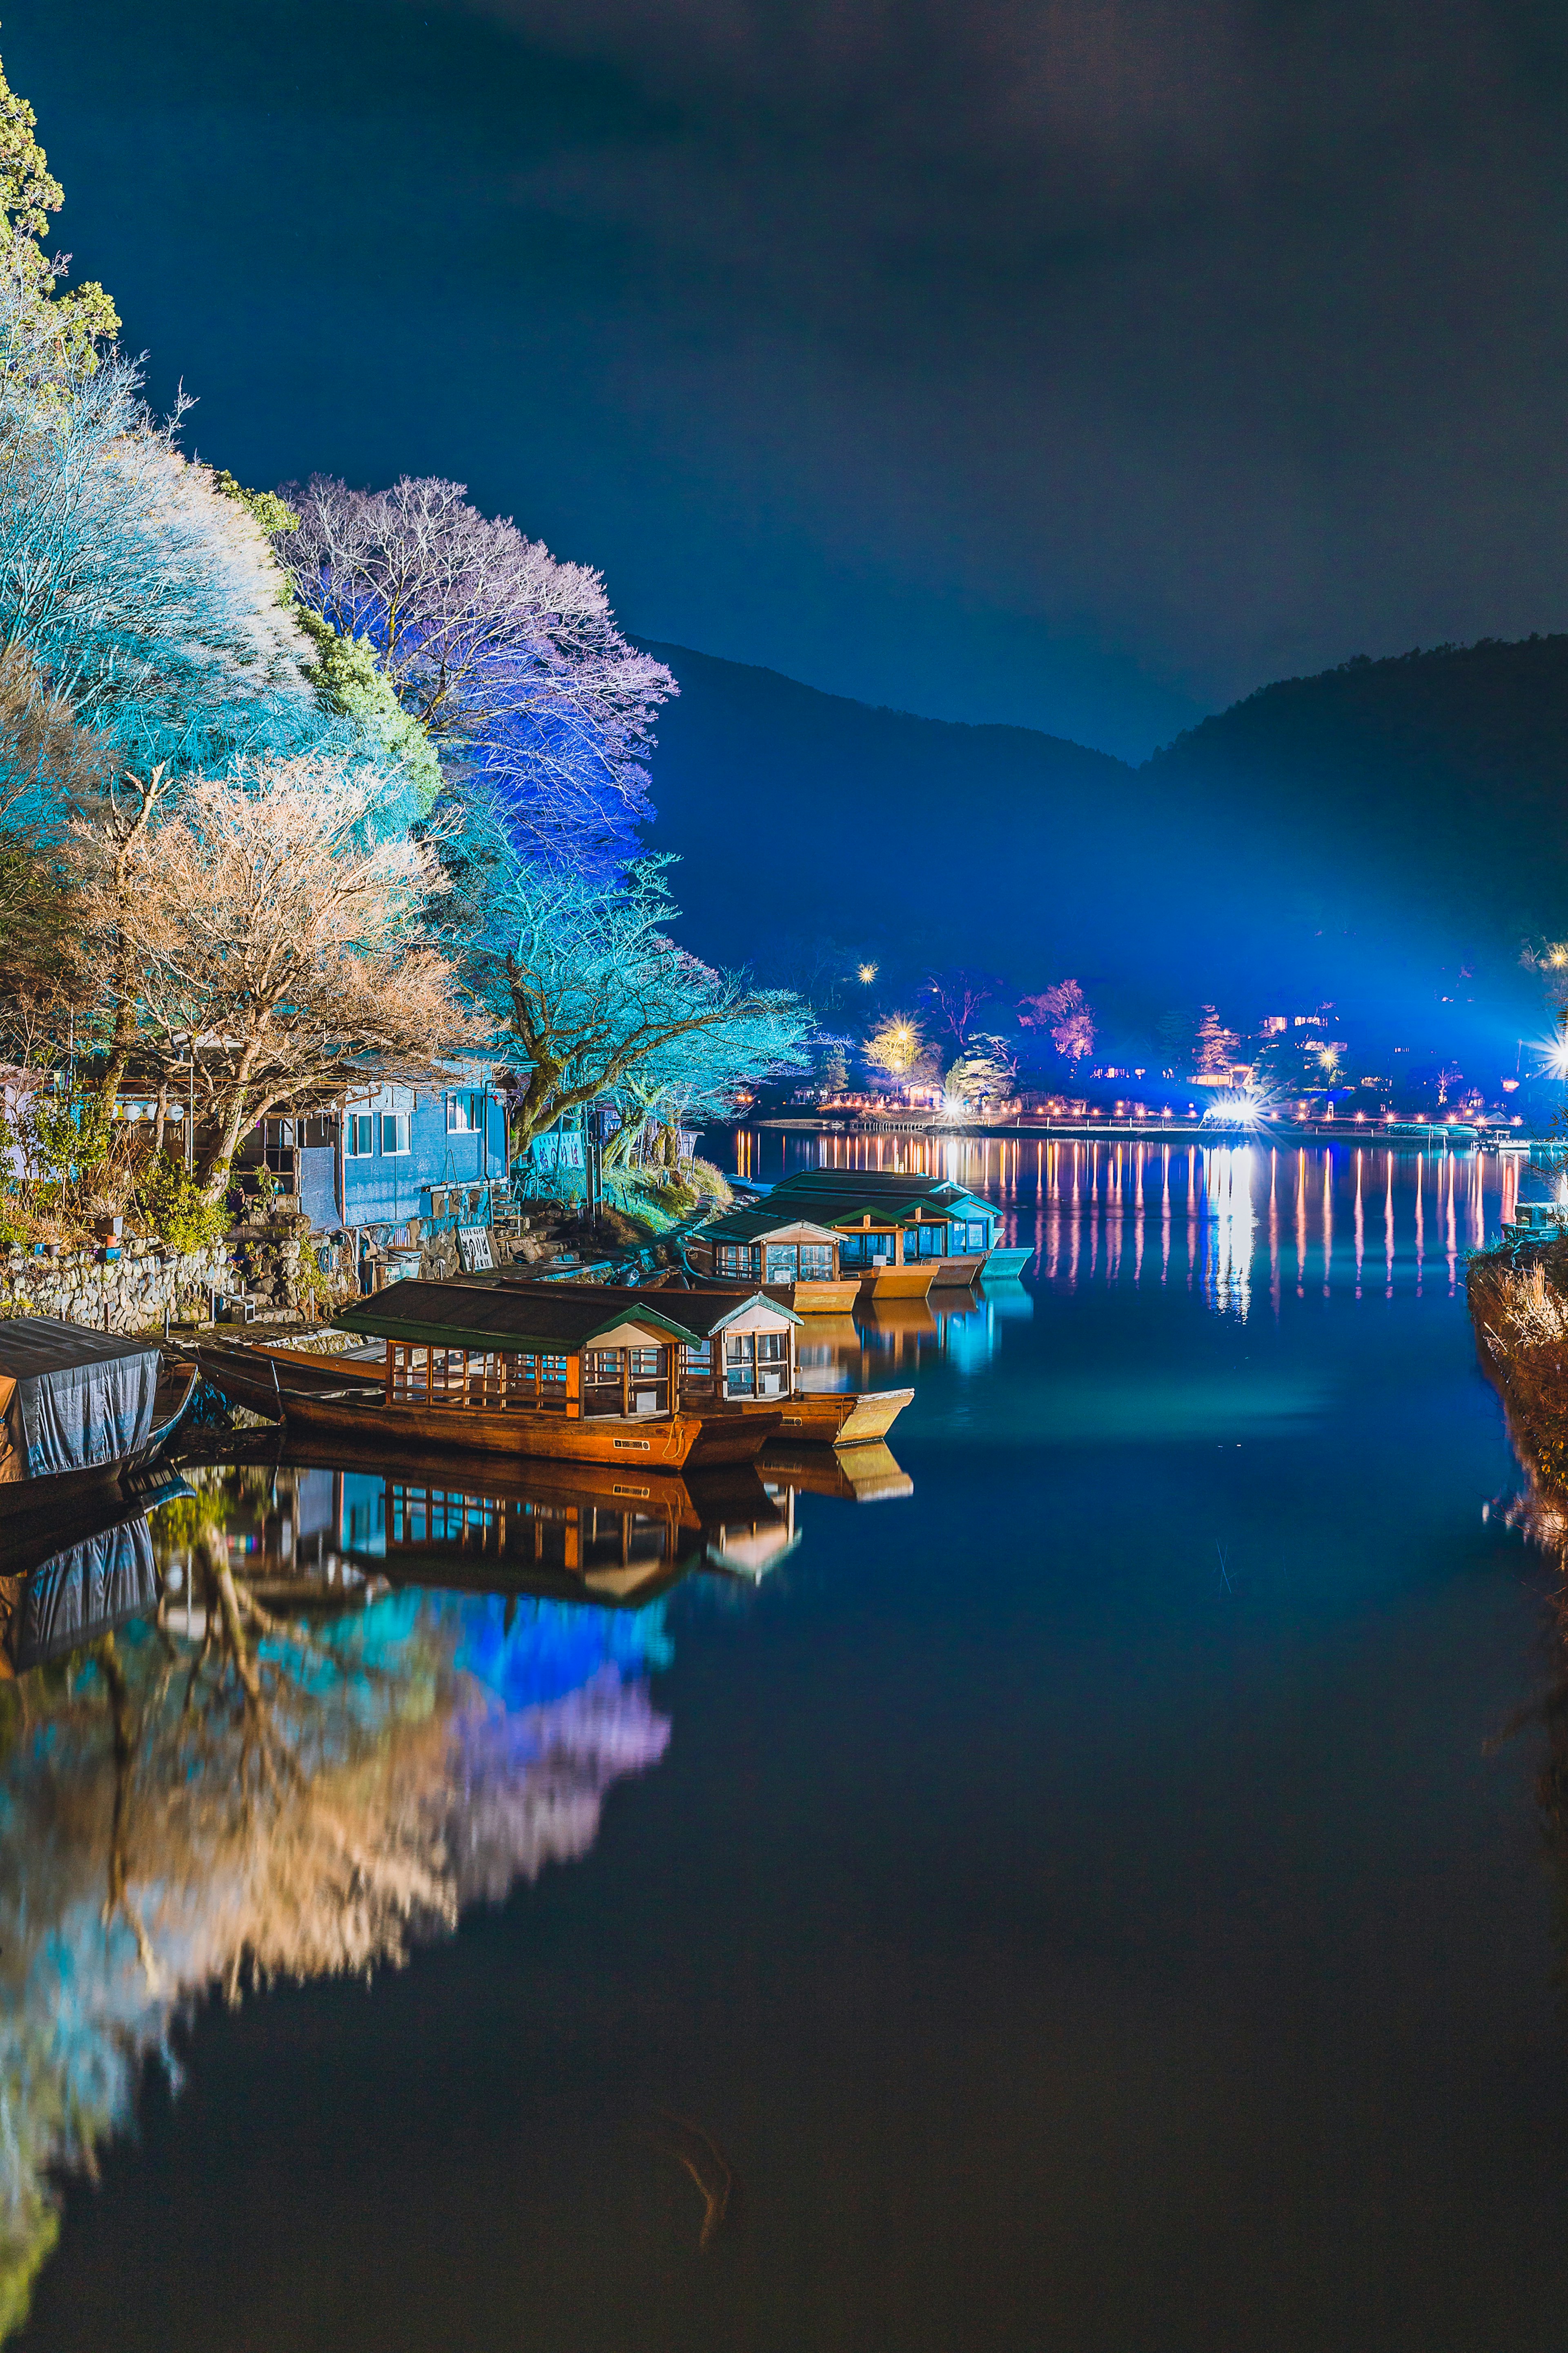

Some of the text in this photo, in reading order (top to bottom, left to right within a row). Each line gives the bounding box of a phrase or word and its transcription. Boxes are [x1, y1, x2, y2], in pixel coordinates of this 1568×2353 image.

[539, 1143, 579, 1169] 船のりば
[462, 1236, 489, 1258] 船のりば
